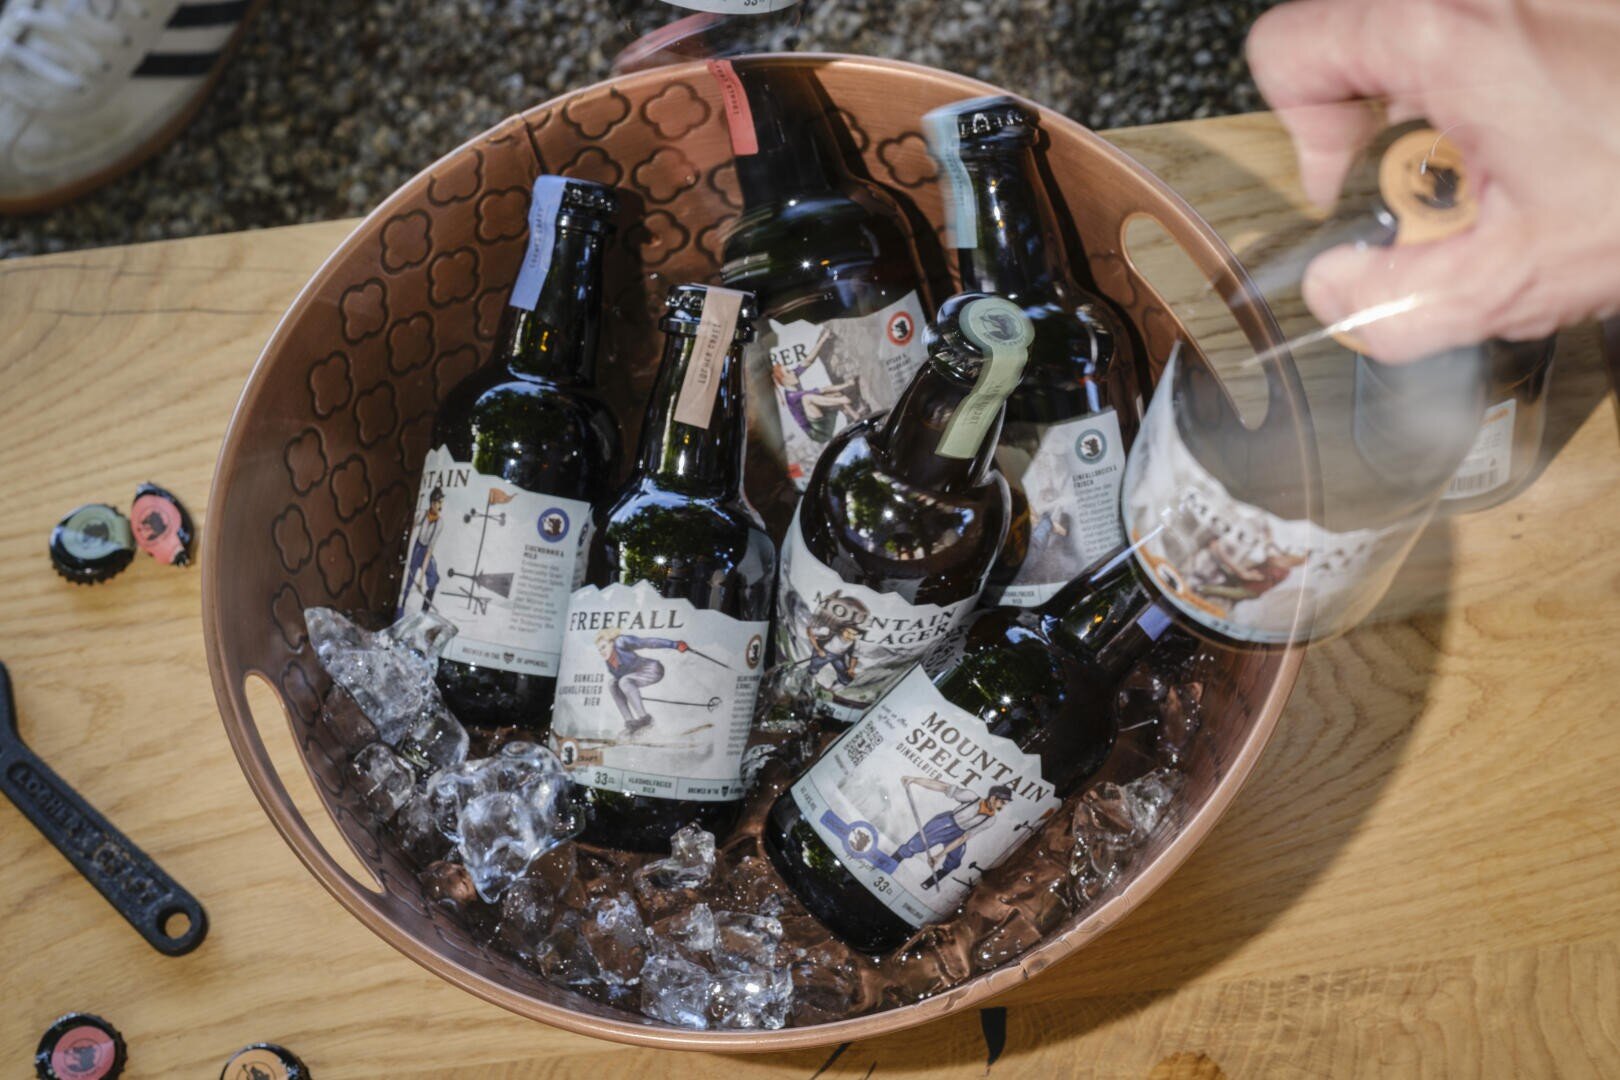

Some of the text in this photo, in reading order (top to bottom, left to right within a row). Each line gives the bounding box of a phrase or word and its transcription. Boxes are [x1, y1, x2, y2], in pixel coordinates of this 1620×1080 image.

[569, 610, 685, 632] FREEFALL
[813, 591, 957, 632] MOUNTAIN
[860, 621, 951, 645] LAGER
[905, 728, 982, 788] SPELT
[921, 711, 1050, 803] MOUNTAIN
[594, 771, 608, 786] 33
[873, 876, 890, 892] 33
